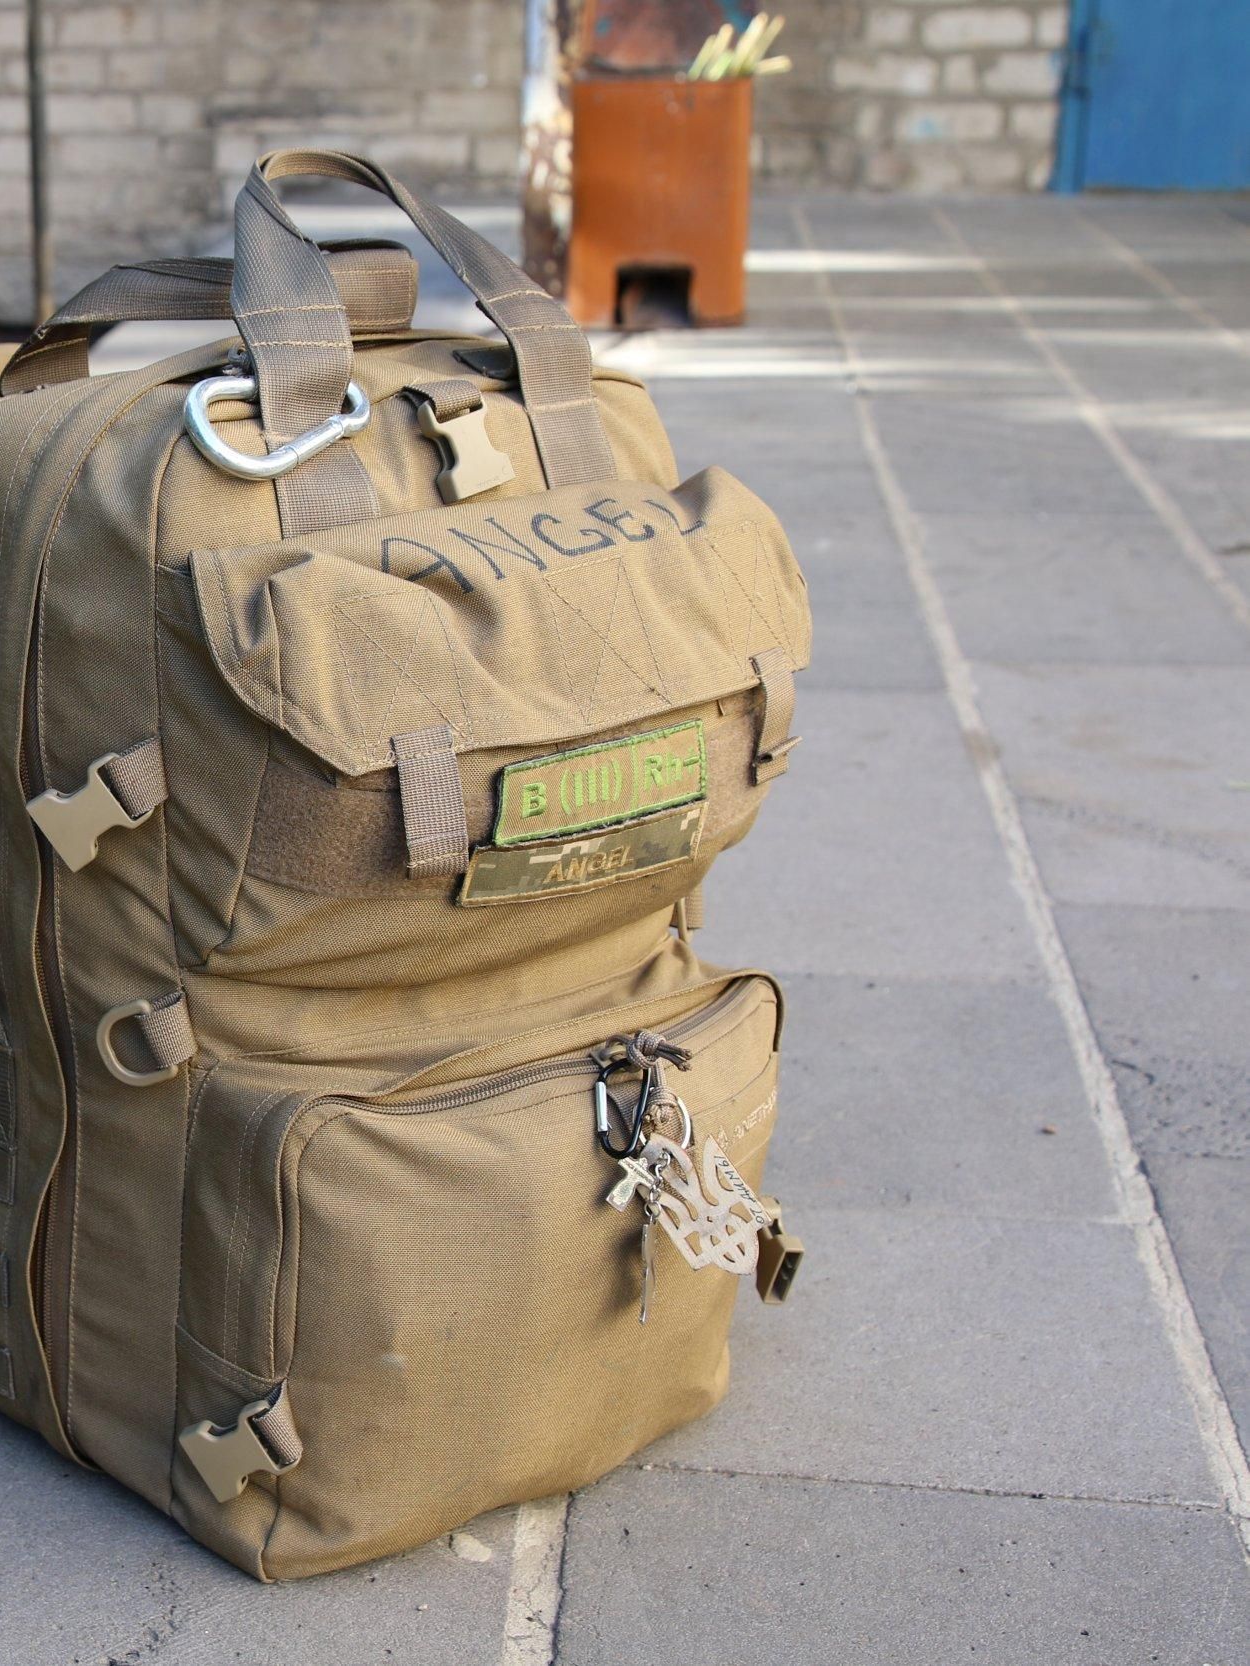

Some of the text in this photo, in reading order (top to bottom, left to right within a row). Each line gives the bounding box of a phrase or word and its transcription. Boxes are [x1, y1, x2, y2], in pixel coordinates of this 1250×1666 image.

[380, 497, 707, 595] ANGEL
[521, 748, 700, 819] B (III) Rh+
[543, 845, 636, 884] ANGEL
